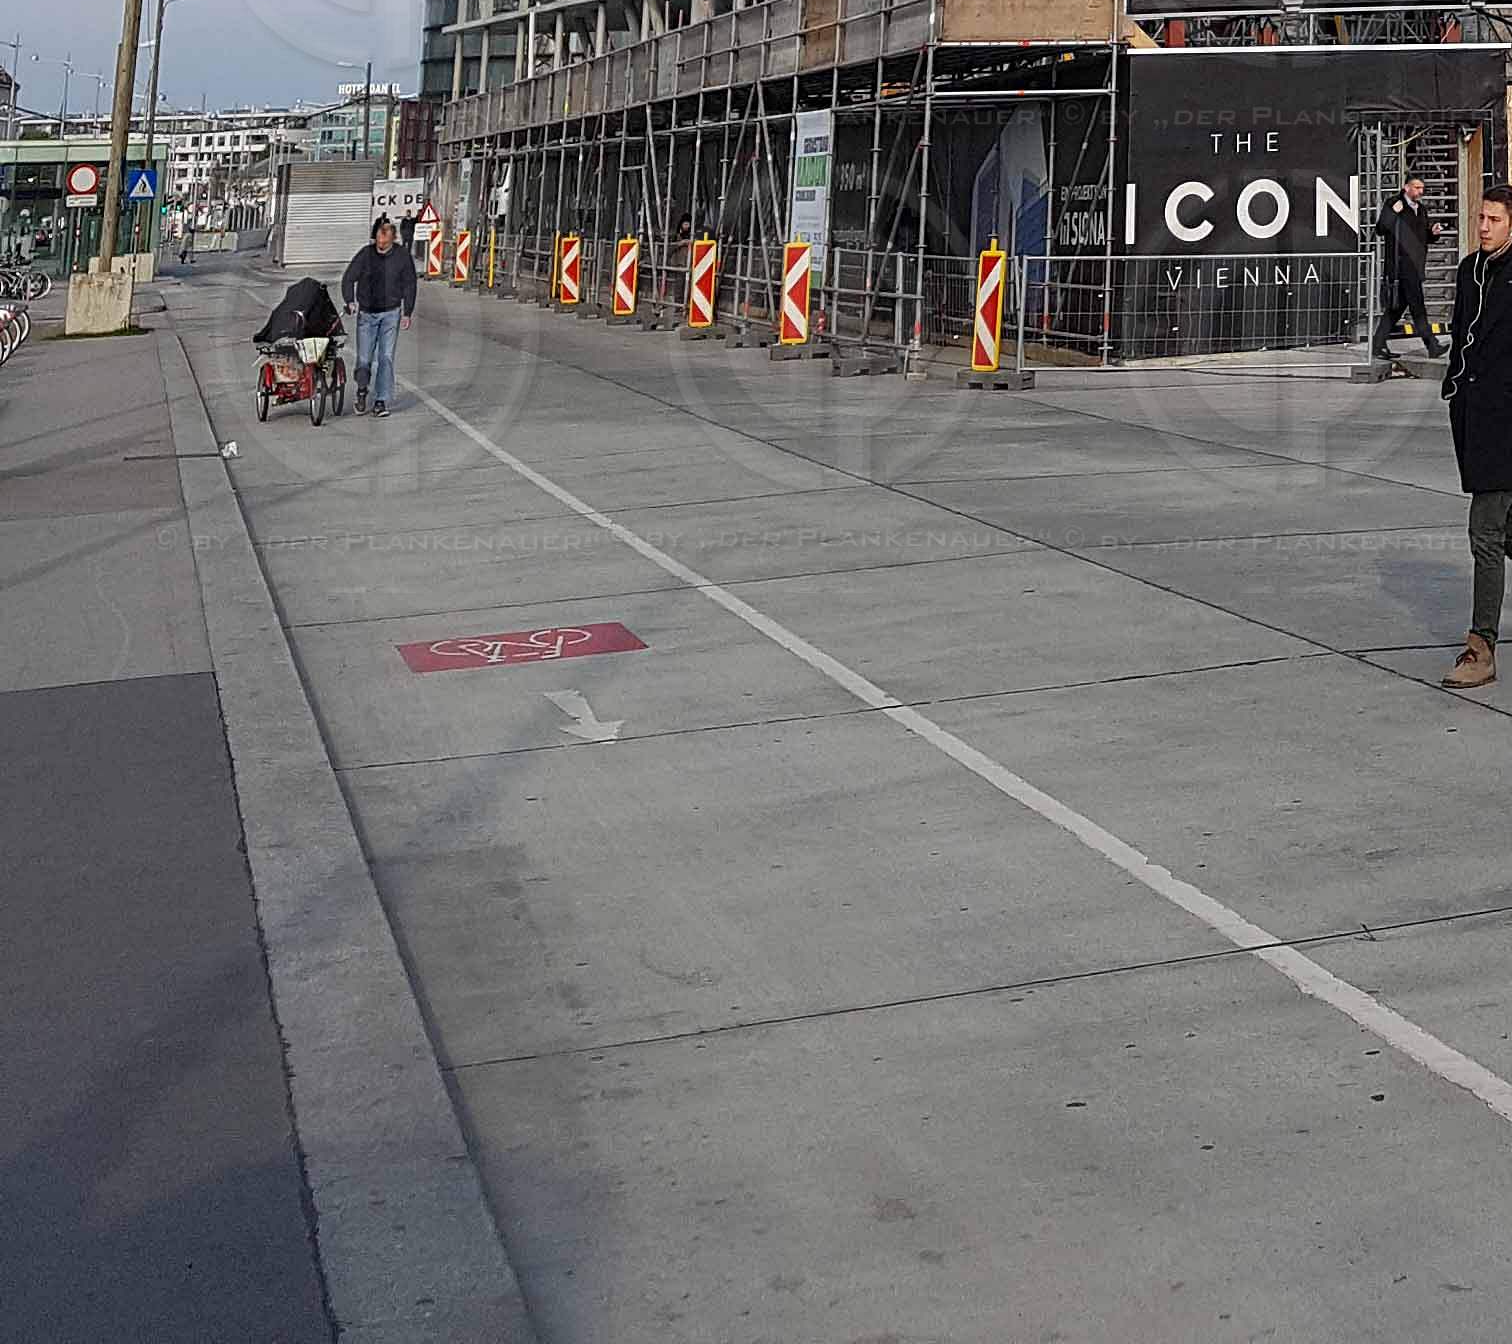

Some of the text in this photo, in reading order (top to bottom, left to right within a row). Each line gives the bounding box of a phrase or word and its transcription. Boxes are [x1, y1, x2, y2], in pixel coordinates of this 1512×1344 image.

[369, 83, 401, 95] DANEL
[1209, 131, 1281, 154] THE
[1124, 175, 1360, 245] ICON
[1166, 263, 1321, 291] VIENNA
